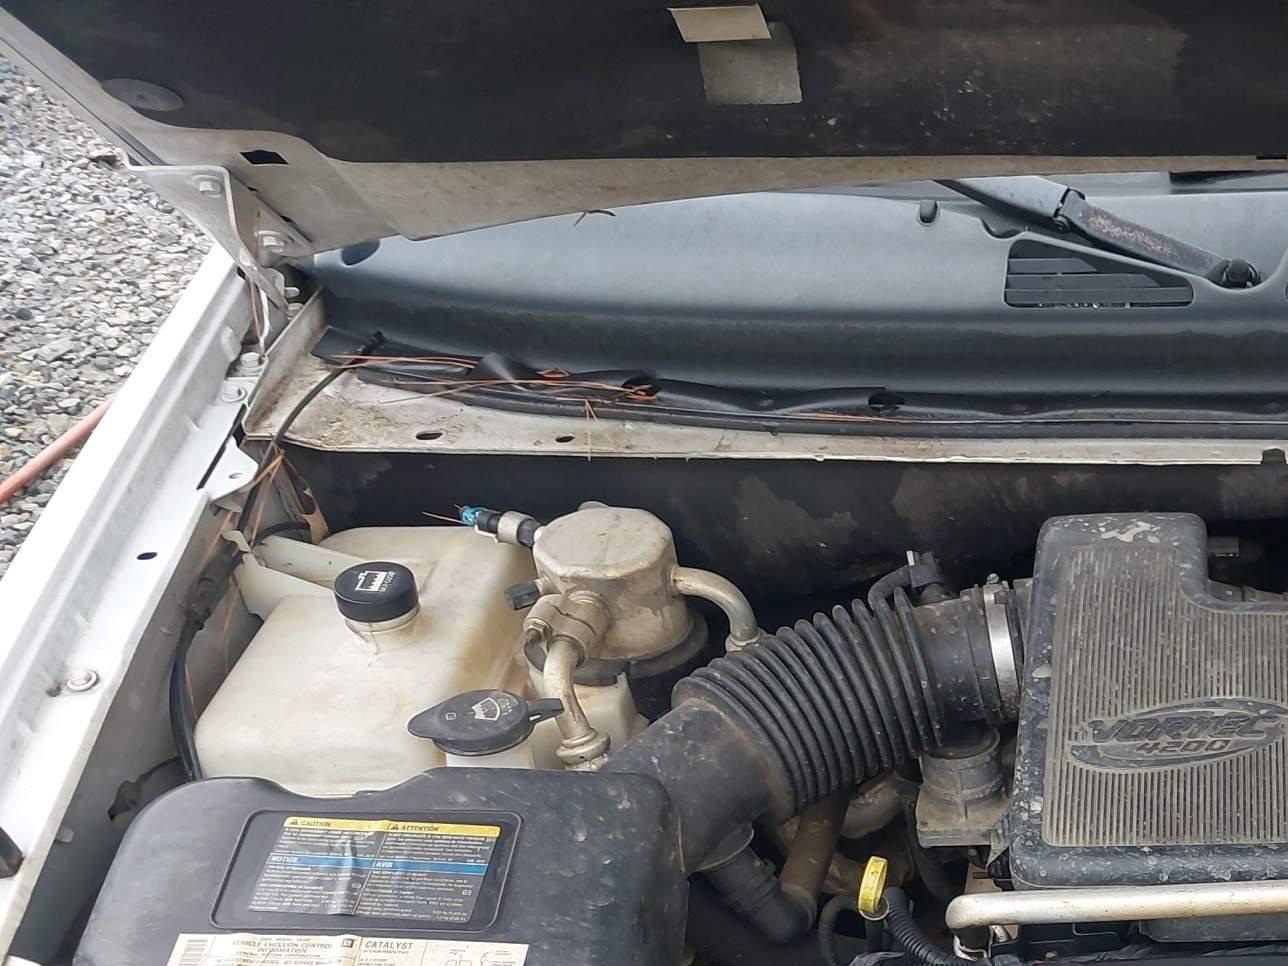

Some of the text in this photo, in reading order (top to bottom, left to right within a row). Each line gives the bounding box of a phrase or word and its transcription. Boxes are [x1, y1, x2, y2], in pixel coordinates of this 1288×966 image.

[1088, 714, 1283, 744] VORTEC
[1136, 739, 1232, 754] 4200
[299, 819, 332, 828] CAUTION
[400, 824, 440, 833] ATTENTION
[270, 855, 299, 864] NOTICE
[375, 861, 393, 869] AVIS
[365, 940, 414, 950] CATALYST
